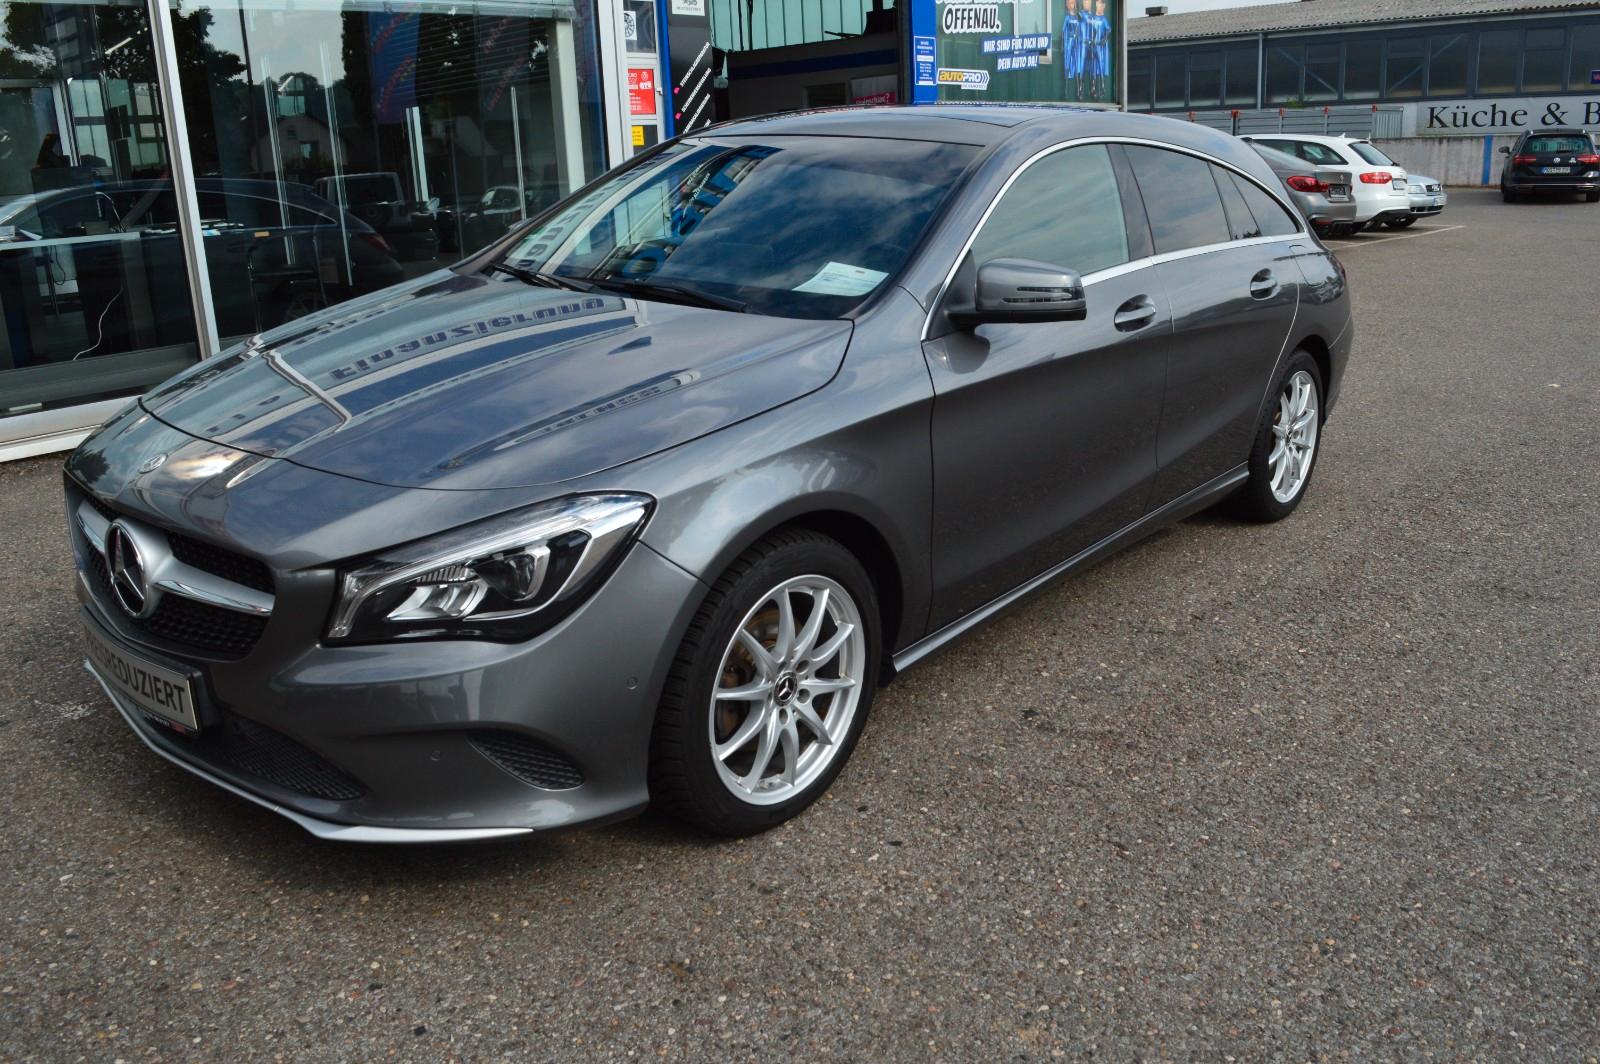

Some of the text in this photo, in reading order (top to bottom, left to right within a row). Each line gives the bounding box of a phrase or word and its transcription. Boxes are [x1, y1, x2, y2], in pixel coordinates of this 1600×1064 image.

[944, 6, 1000, 31] OFFENAU.
[983, 35, 1049, 53] WIR SIND FÜR DICH UND
[997, 55, 1038, 70] DEIN AUTO DA!
[1427, 103, 1528, 129] Küche
[1541, 102, 1569, 126] &
